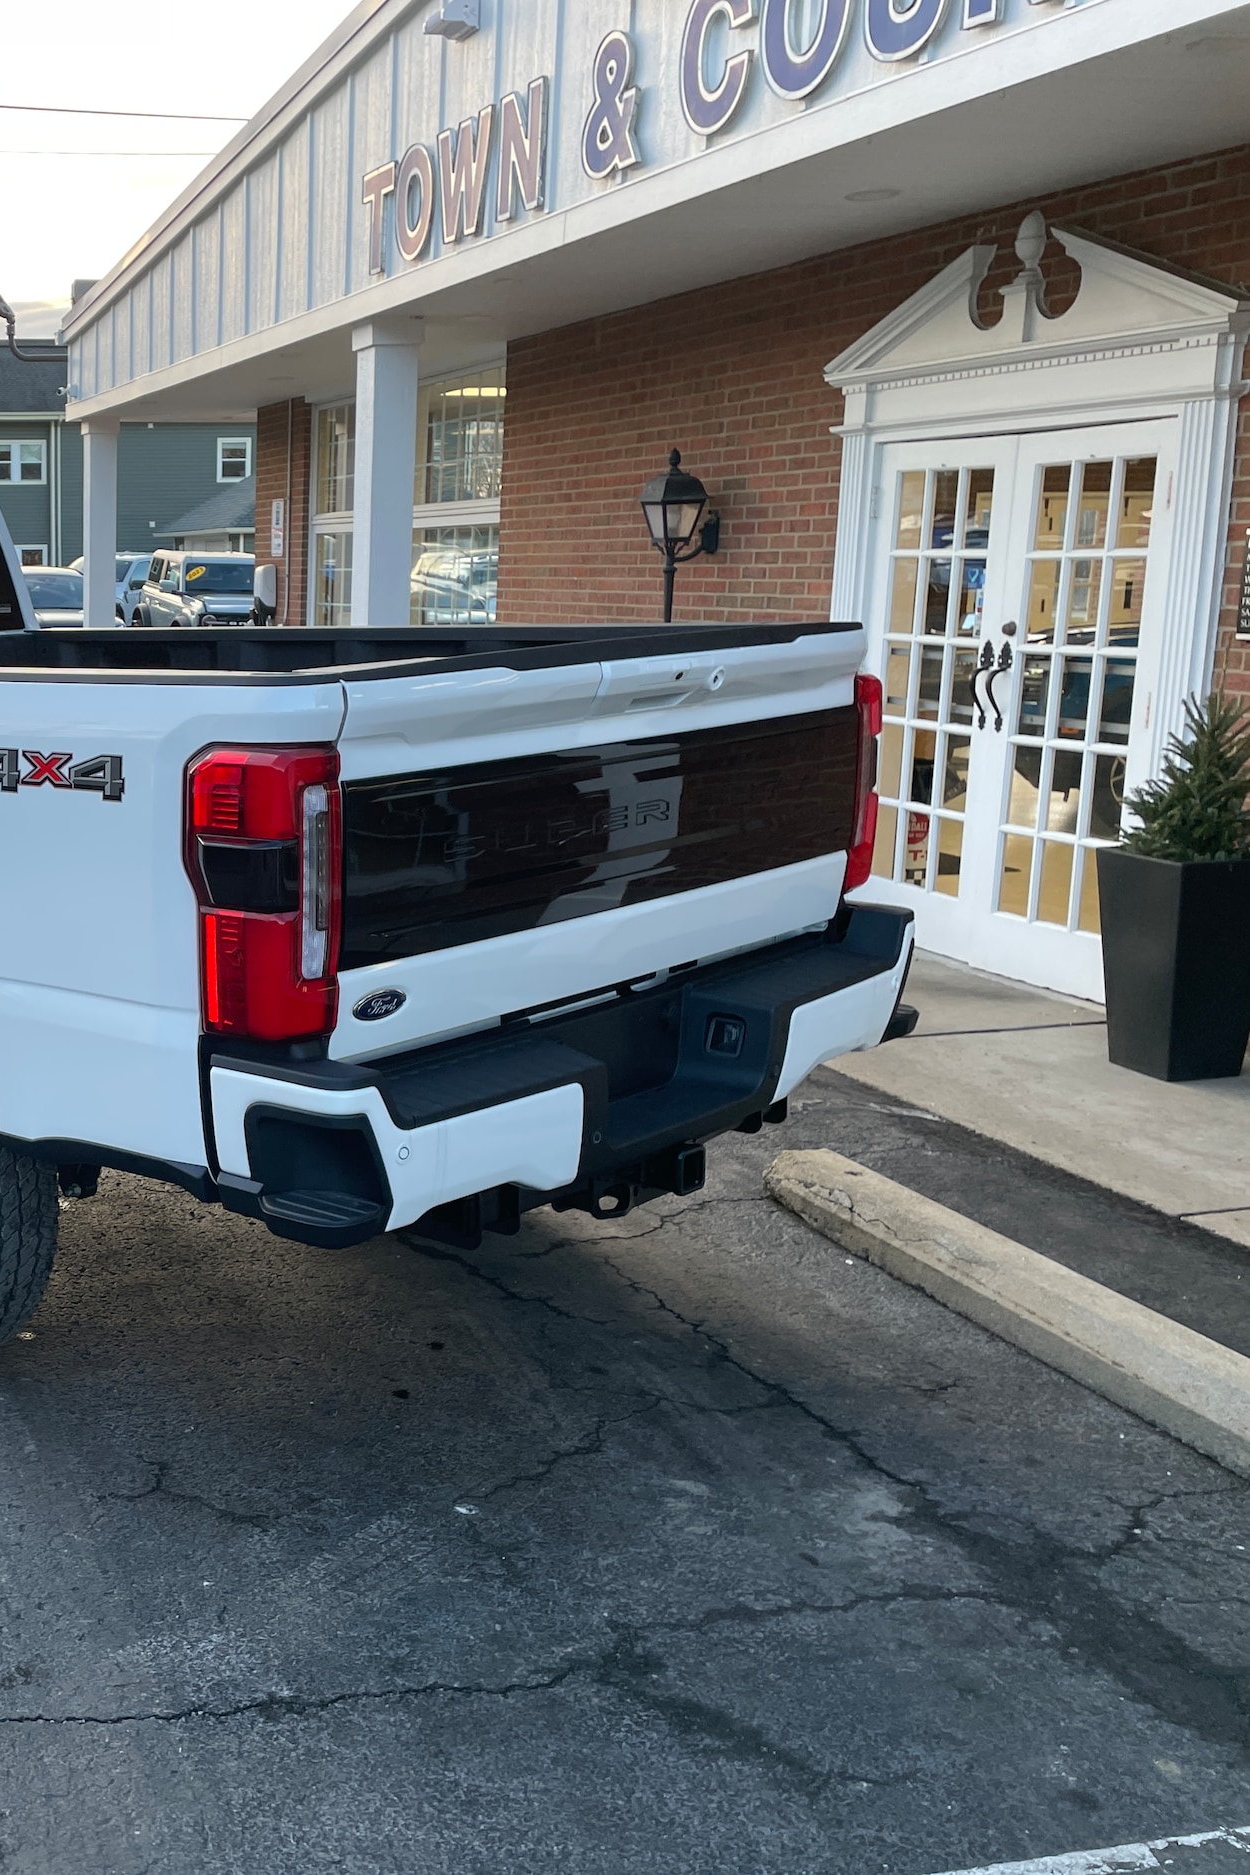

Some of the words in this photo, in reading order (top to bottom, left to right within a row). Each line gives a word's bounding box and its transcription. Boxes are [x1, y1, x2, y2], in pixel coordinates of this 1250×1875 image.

[362, 75, 548, 276] TOWN
[581, 30, 642, 180] &
[679, 0, 1050, 136] CO
[444, 798, 671, 864] SUPER
